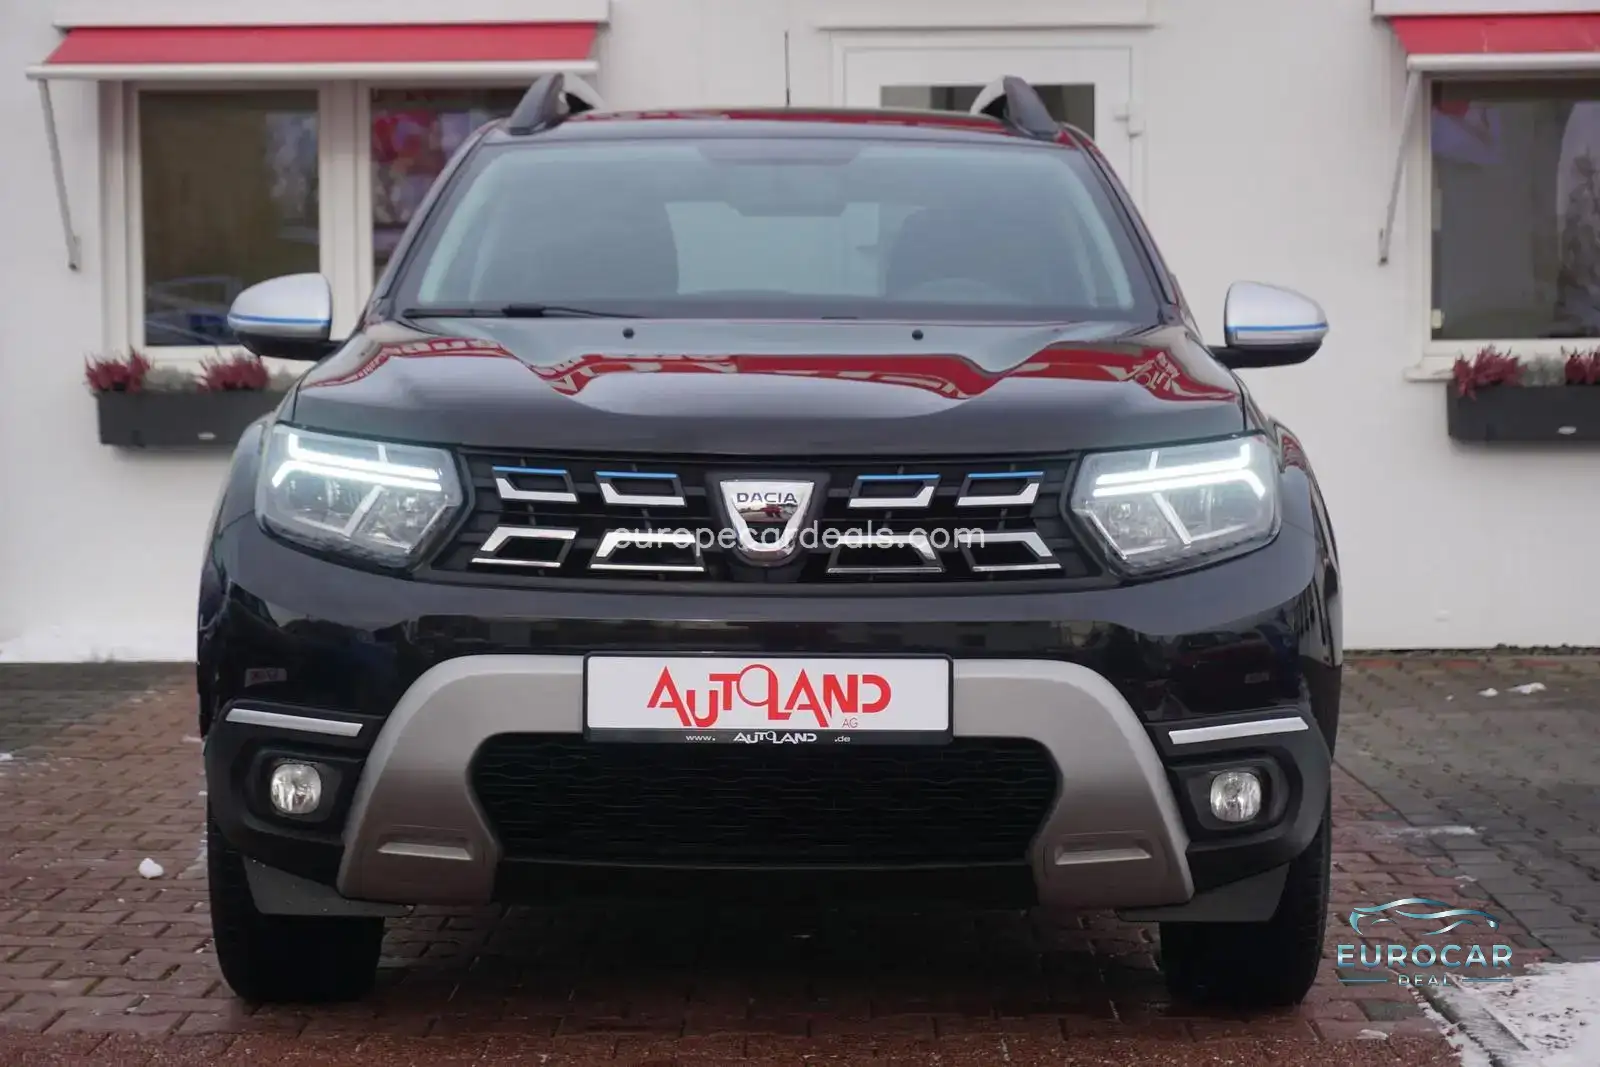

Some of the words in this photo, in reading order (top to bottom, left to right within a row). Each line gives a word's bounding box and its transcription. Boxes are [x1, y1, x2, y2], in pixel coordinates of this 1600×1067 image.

[736, 492, 798, 504] DACIA
[647, 664, 892, 728] AUTOLAND
[842, 717, 859, 729] AG
[733, 731, 818, 744] AUTOLAND
